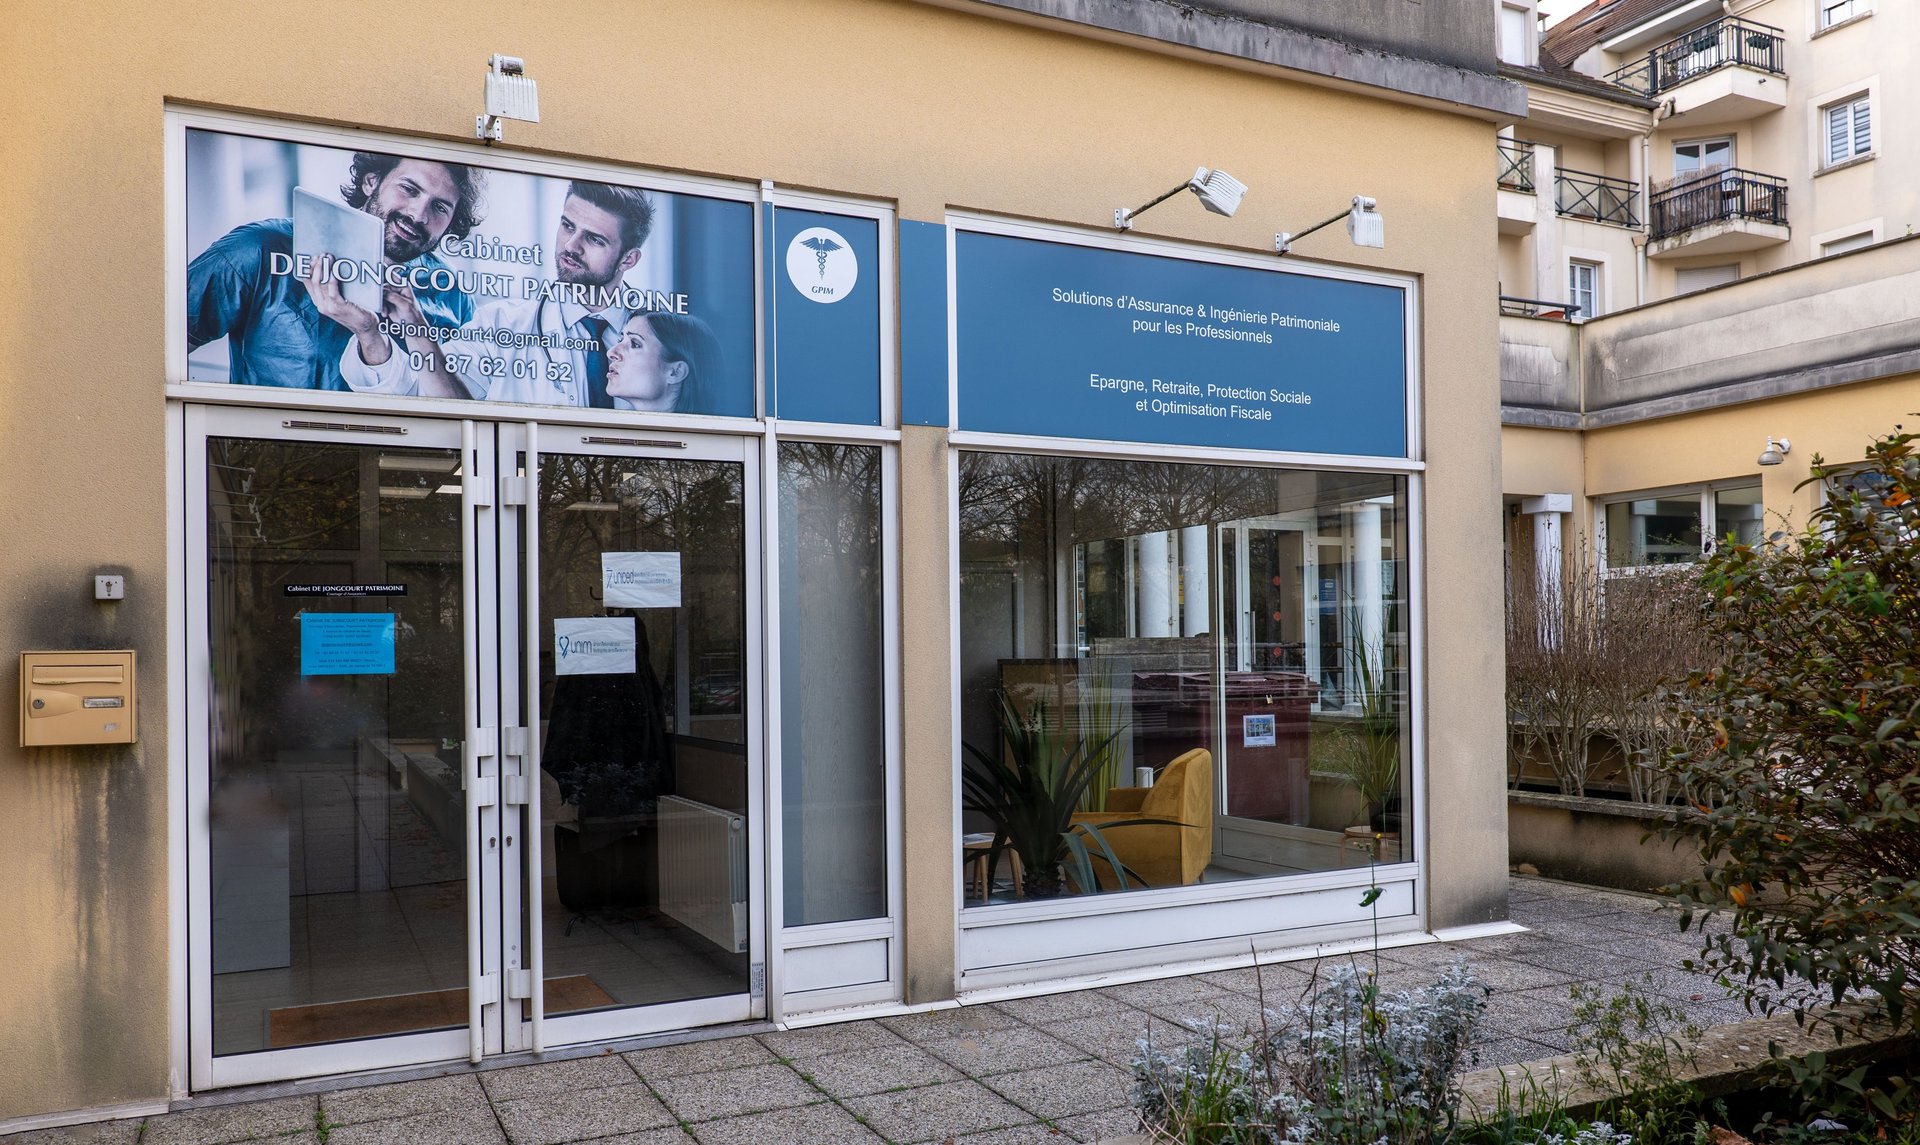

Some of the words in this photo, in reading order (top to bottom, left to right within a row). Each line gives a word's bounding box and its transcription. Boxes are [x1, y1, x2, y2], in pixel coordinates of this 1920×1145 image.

[440, 233, 542, 265] Cabinet
[270, 252, 312, 278] DE
[320, 257, 514, 297] JONGCOURT
[523, 278, 689, 315] PATRIMOINE
[811, 285, 834, 295] GPIM
[1052, 287, 1113, 308] Solutions
[1117, 295, 1194, 316] d'Assurance
[1197, 304, 1207, 318] &
[1210, 305, 1268, 324] Ingénierie
[1271, 312, 1340, 333] Patrimoniale
[378, 319, 599, 352] dejongcourt4@gmail.com
[1133, 320, 1161, 334] pour
[1164, 319, 1183, 335] les
[1186, 323, 1273, 344] Professionnels
[410, 351, 436, 372] 01
[445, 354, 472, 374] 87
[479, 356, 506, 377] 62
[513, 359, 538, 380] 01
[546, 362, 573, 382] 52
[1090, 373, 1148, 393] Epargne,
[1152, 379, 1203, 398] Retraite,
[1207, 384, 1267, 401] Protection
[1270, 389, 1312, 405] Sociale
[1136, 400, 1148, 412] et
[1151, 398, 1227, 418] Optimisation
[1230, 404, 1272, 421] Fiscale
